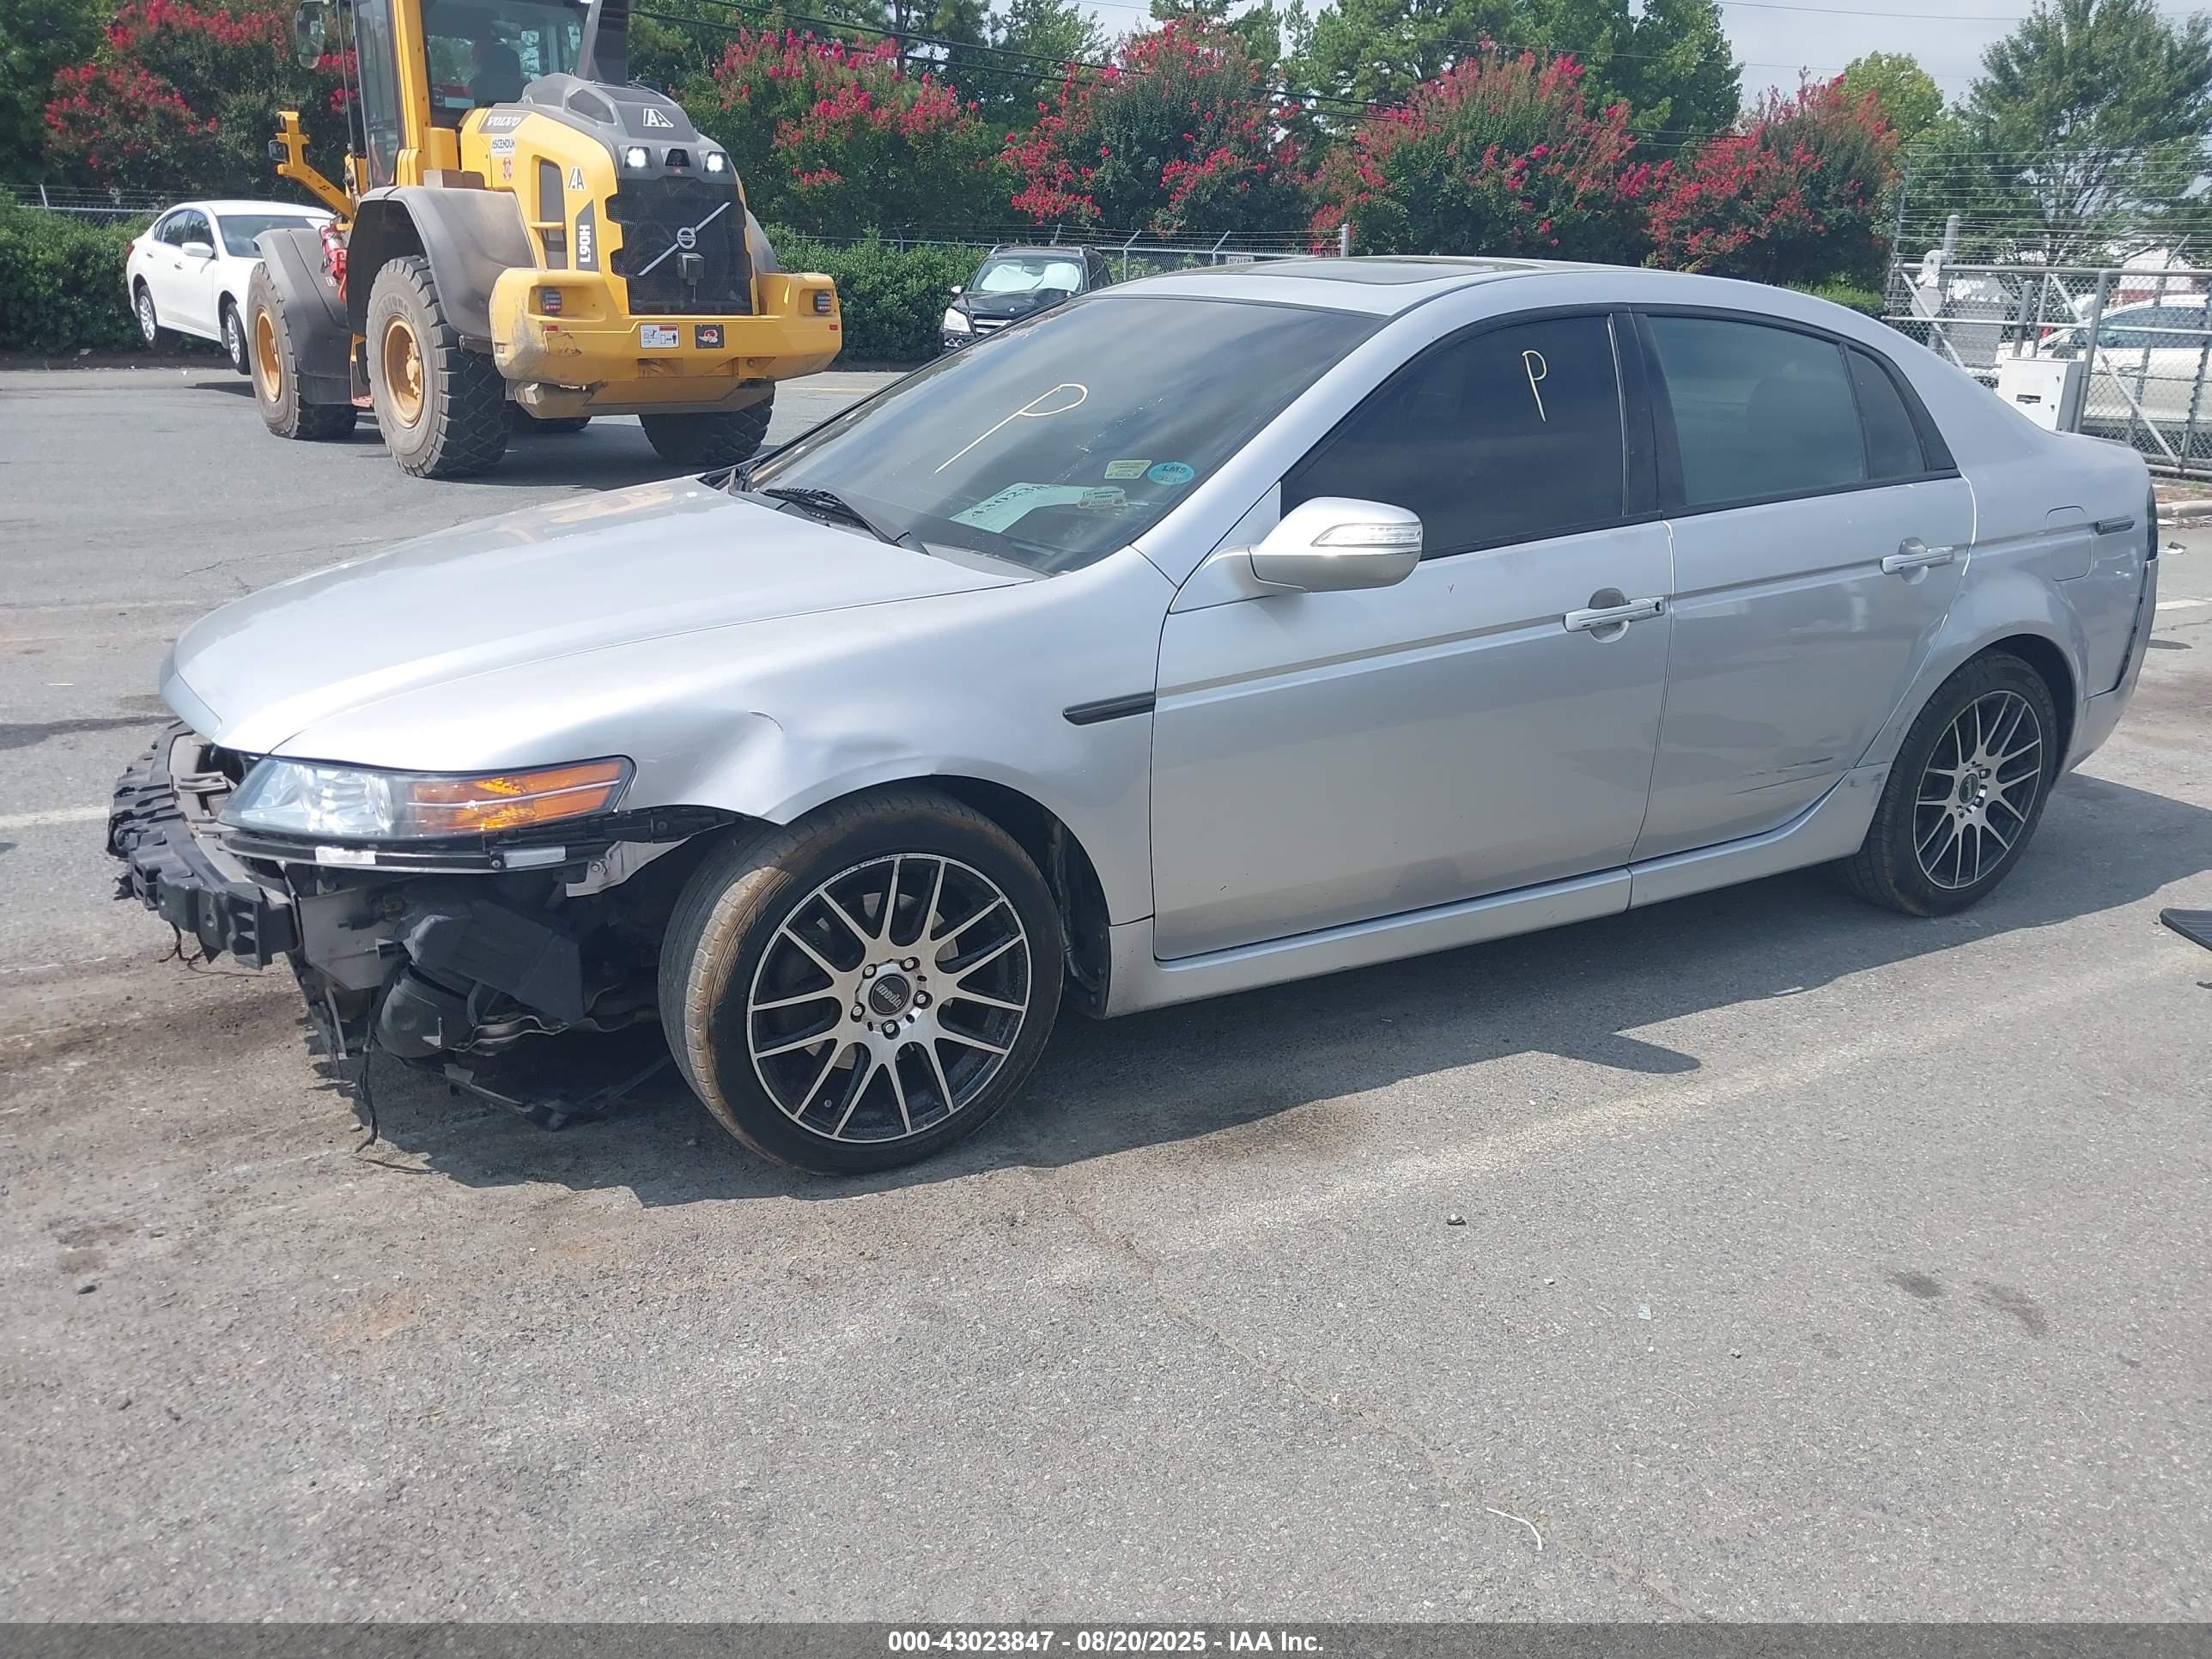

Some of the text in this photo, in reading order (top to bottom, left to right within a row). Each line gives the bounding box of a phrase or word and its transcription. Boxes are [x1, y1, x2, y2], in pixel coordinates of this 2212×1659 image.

[487, 116, 521, 126] VOLVO
[579, 224, 592, 263] L90H
[1522, 349, 1547, 422] P
[934, 383, 1088, 474] P
